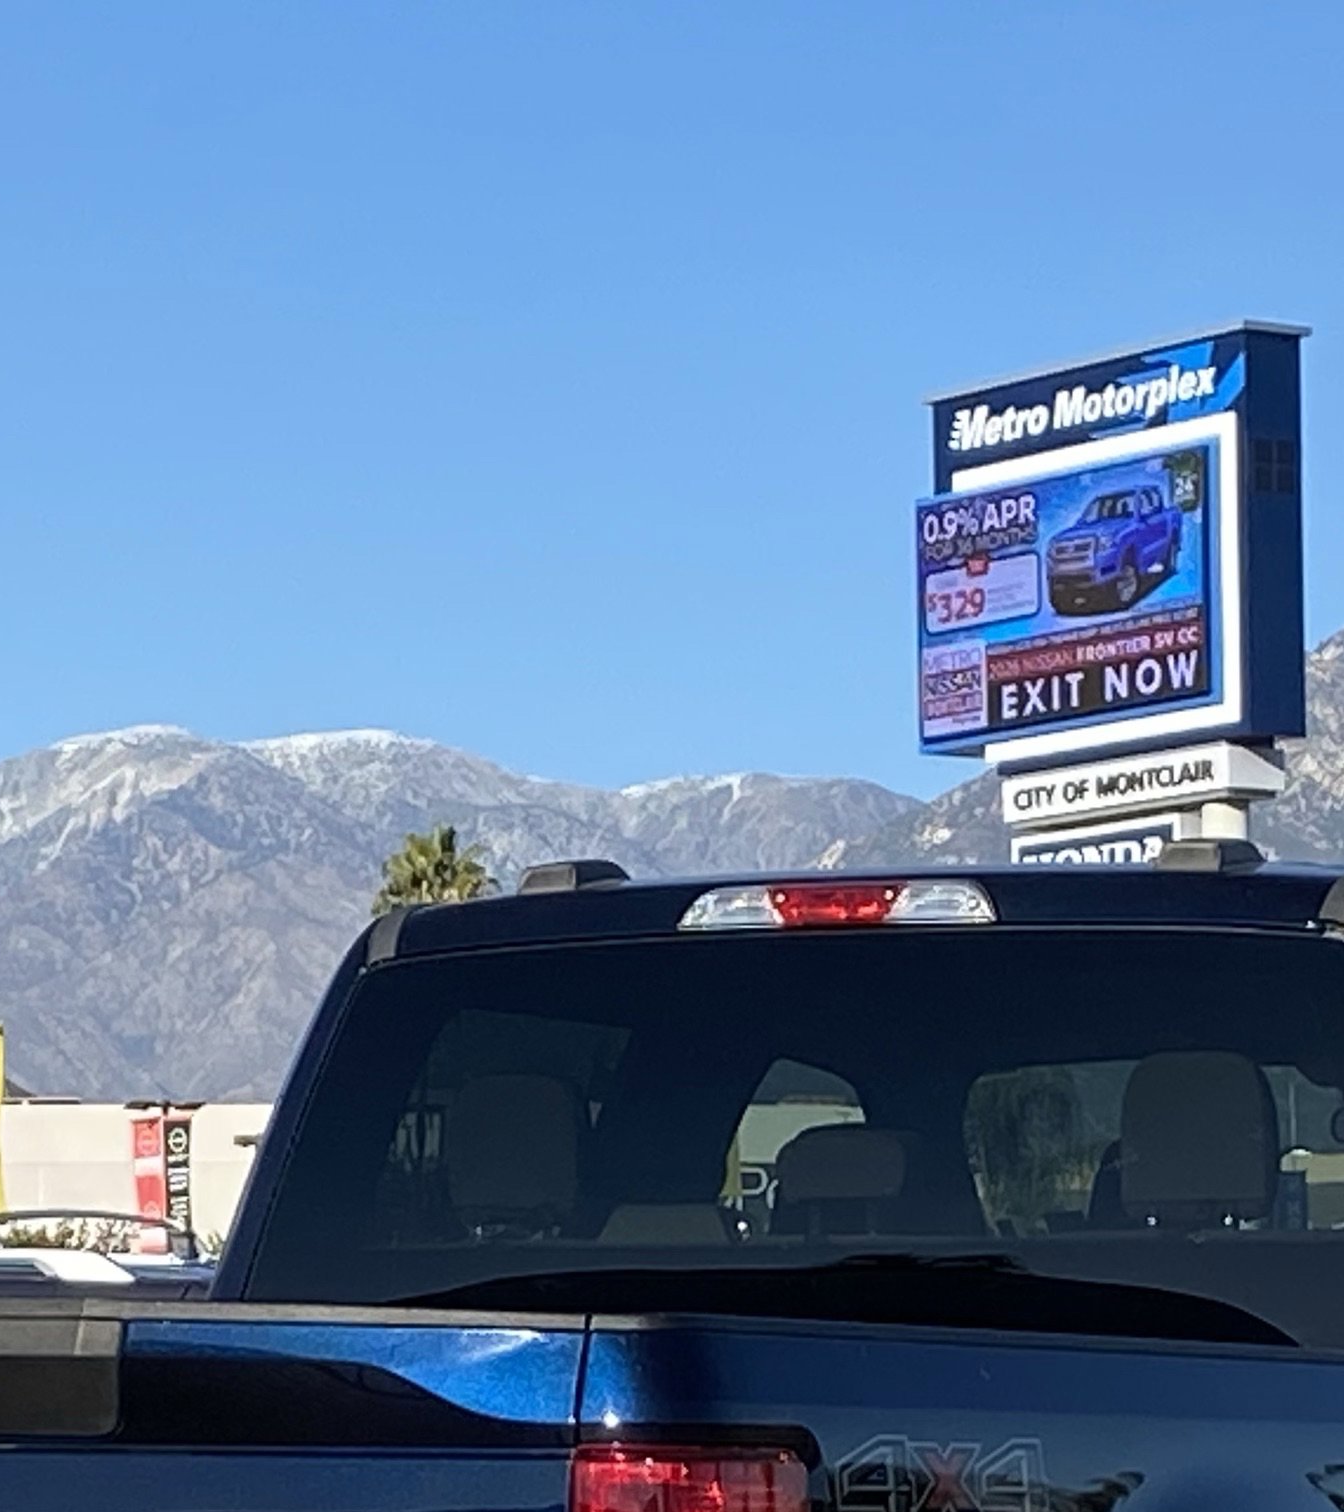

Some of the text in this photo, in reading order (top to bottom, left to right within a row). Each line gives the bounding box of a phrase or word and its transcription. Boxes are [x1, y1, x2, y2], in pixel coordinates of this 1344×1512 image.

[949, 365, 1216, 451] Metro Motorplex
[923, 494, 1036, 543] 0.9% APR
[1076, 635, 1152, 662] FRONTIER
[1154, 629, 1175, 649] SV
[1177, 625, 1200, 644] CC
[1001, 671, 1085, 720] EXIT
[1104, 650, 1199, 702] NOW
[1013, 760, 1215, 811] CITY OF MONTCLAIR
